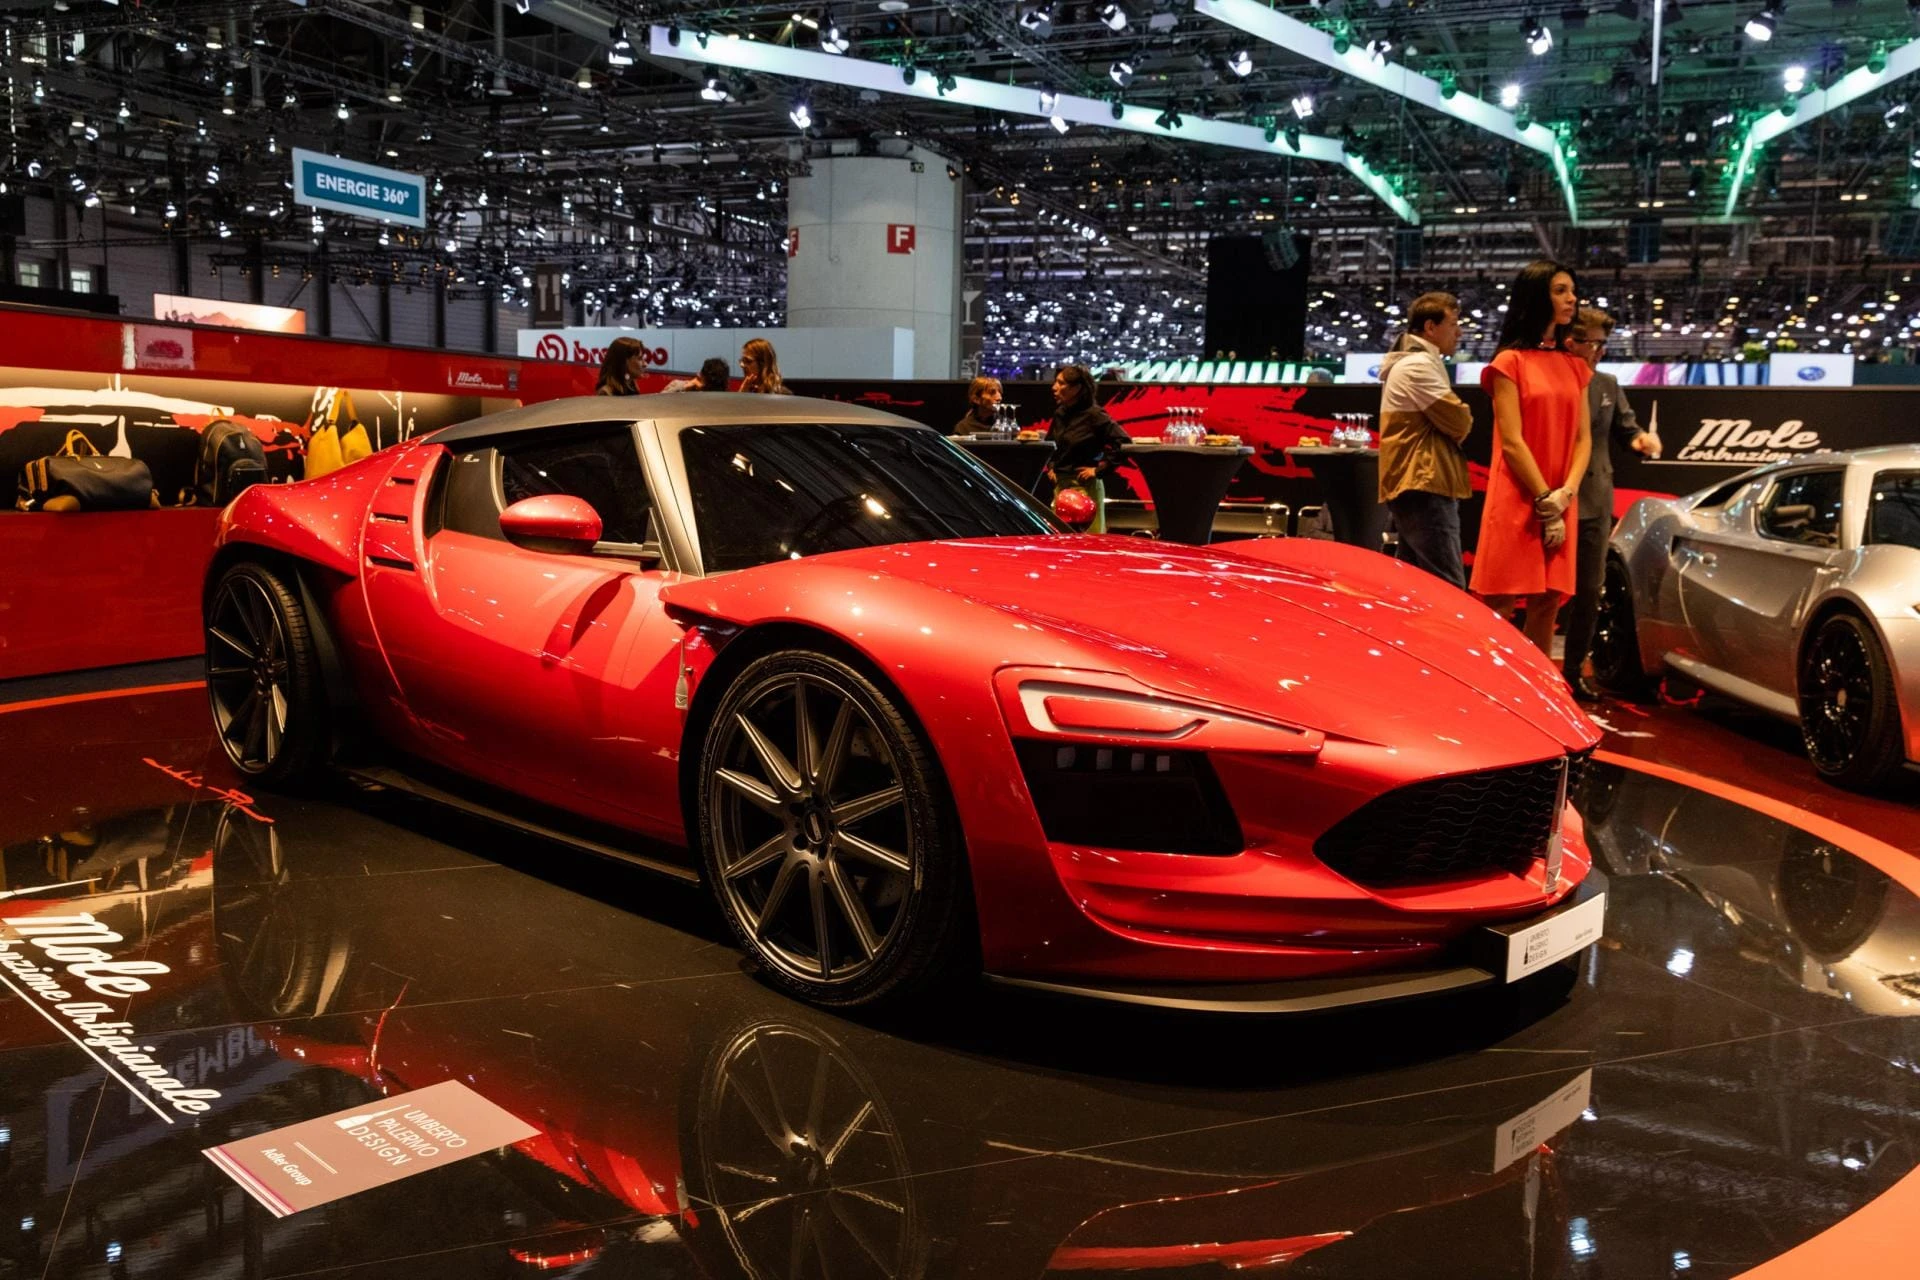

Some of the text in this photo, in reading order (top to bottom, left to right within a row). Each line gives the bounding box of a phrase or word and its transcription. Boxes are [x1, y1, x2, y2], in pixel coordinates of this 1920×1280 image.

[316, 172, 380, 200] ENERGIE
[895, 226, 910, 248] F
[1688, 418, 1821, 449] Mole
[1676, 446, 1802, 462] Costruzion
[2, 912, 171, 998] Mole
[54, 1002, 222, 1115] Artigianale
[347, 1125, 413, 1166] DESIGN
[374, 1118, 440, 1157] PALERMO
[403, 1109, 468, 1148] UMBERTO
[260, 1148, 313, 1185] Adler Group
